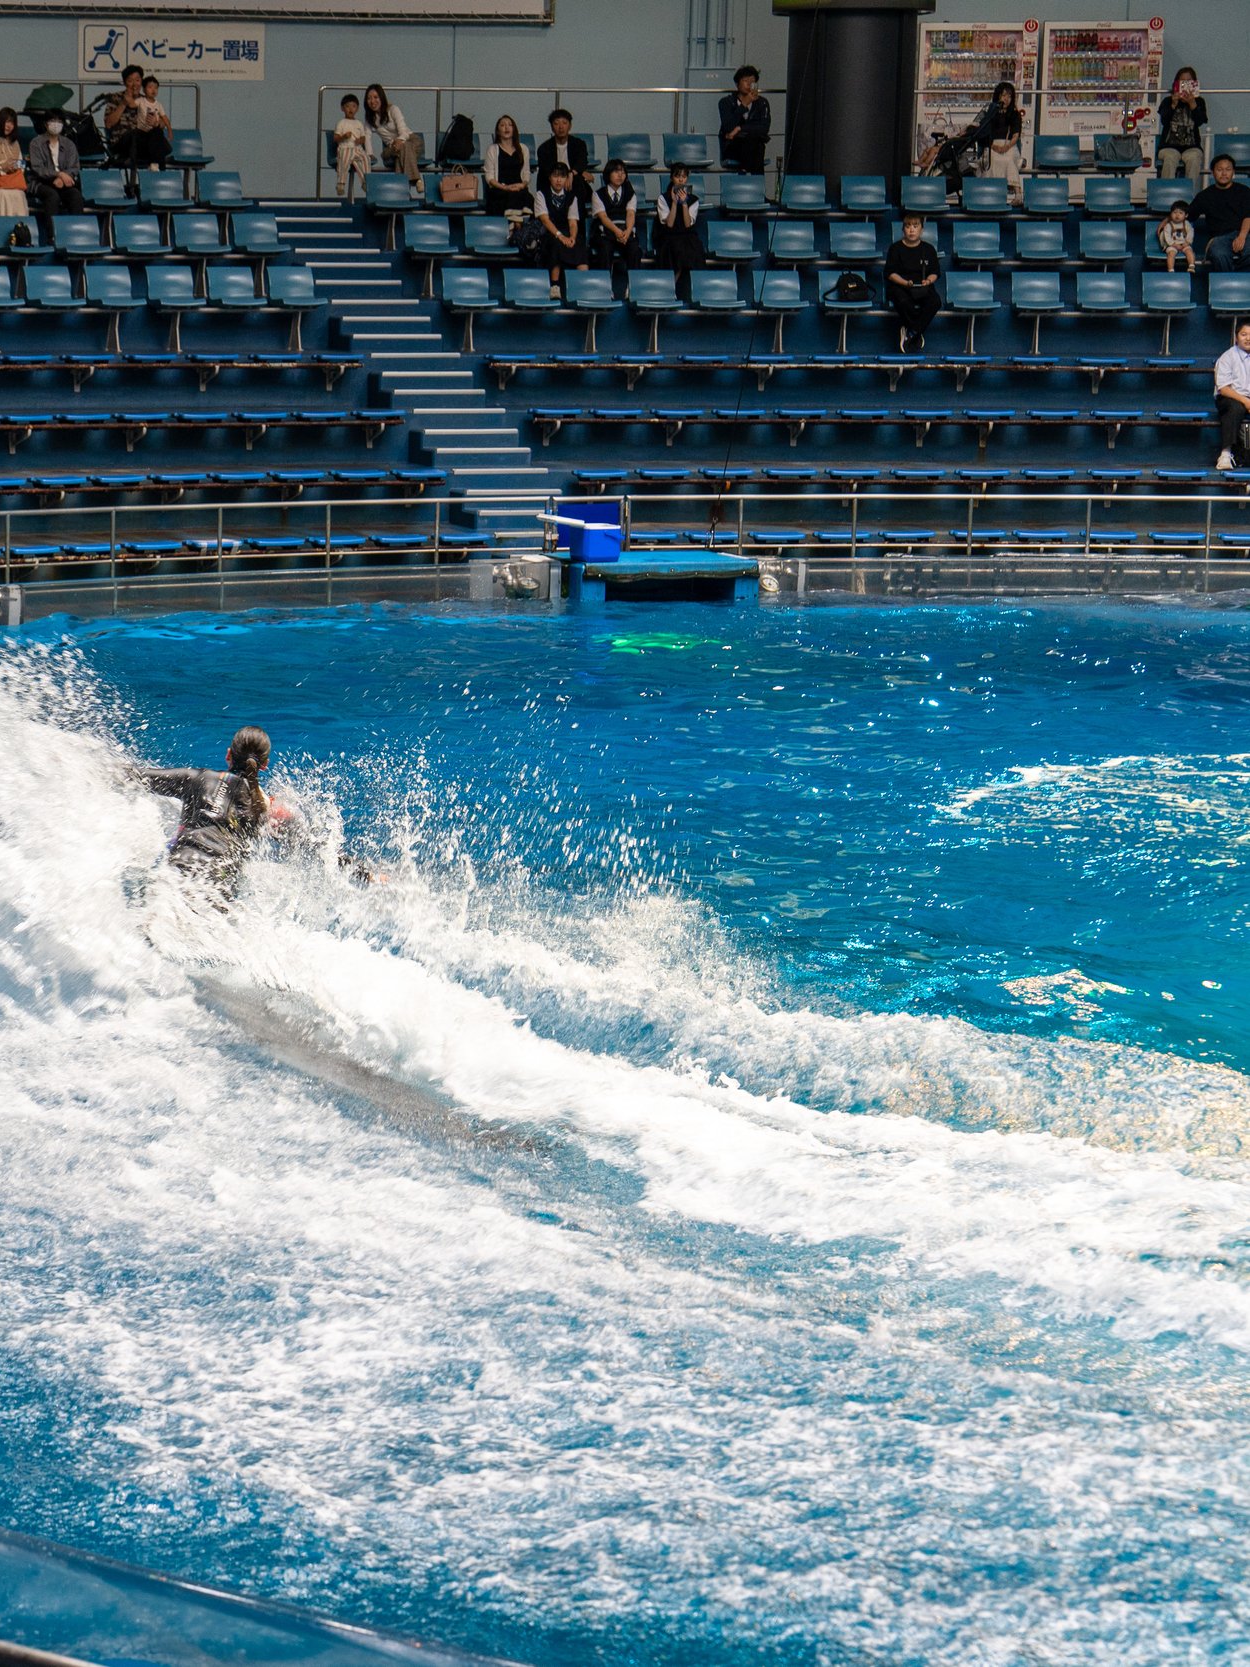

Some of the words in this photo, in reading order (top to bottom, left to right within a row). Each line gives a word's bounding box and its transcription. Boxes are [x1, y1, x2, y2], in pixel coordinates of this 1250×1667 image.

[132, 38, 259, 61] ベビーカー置場
